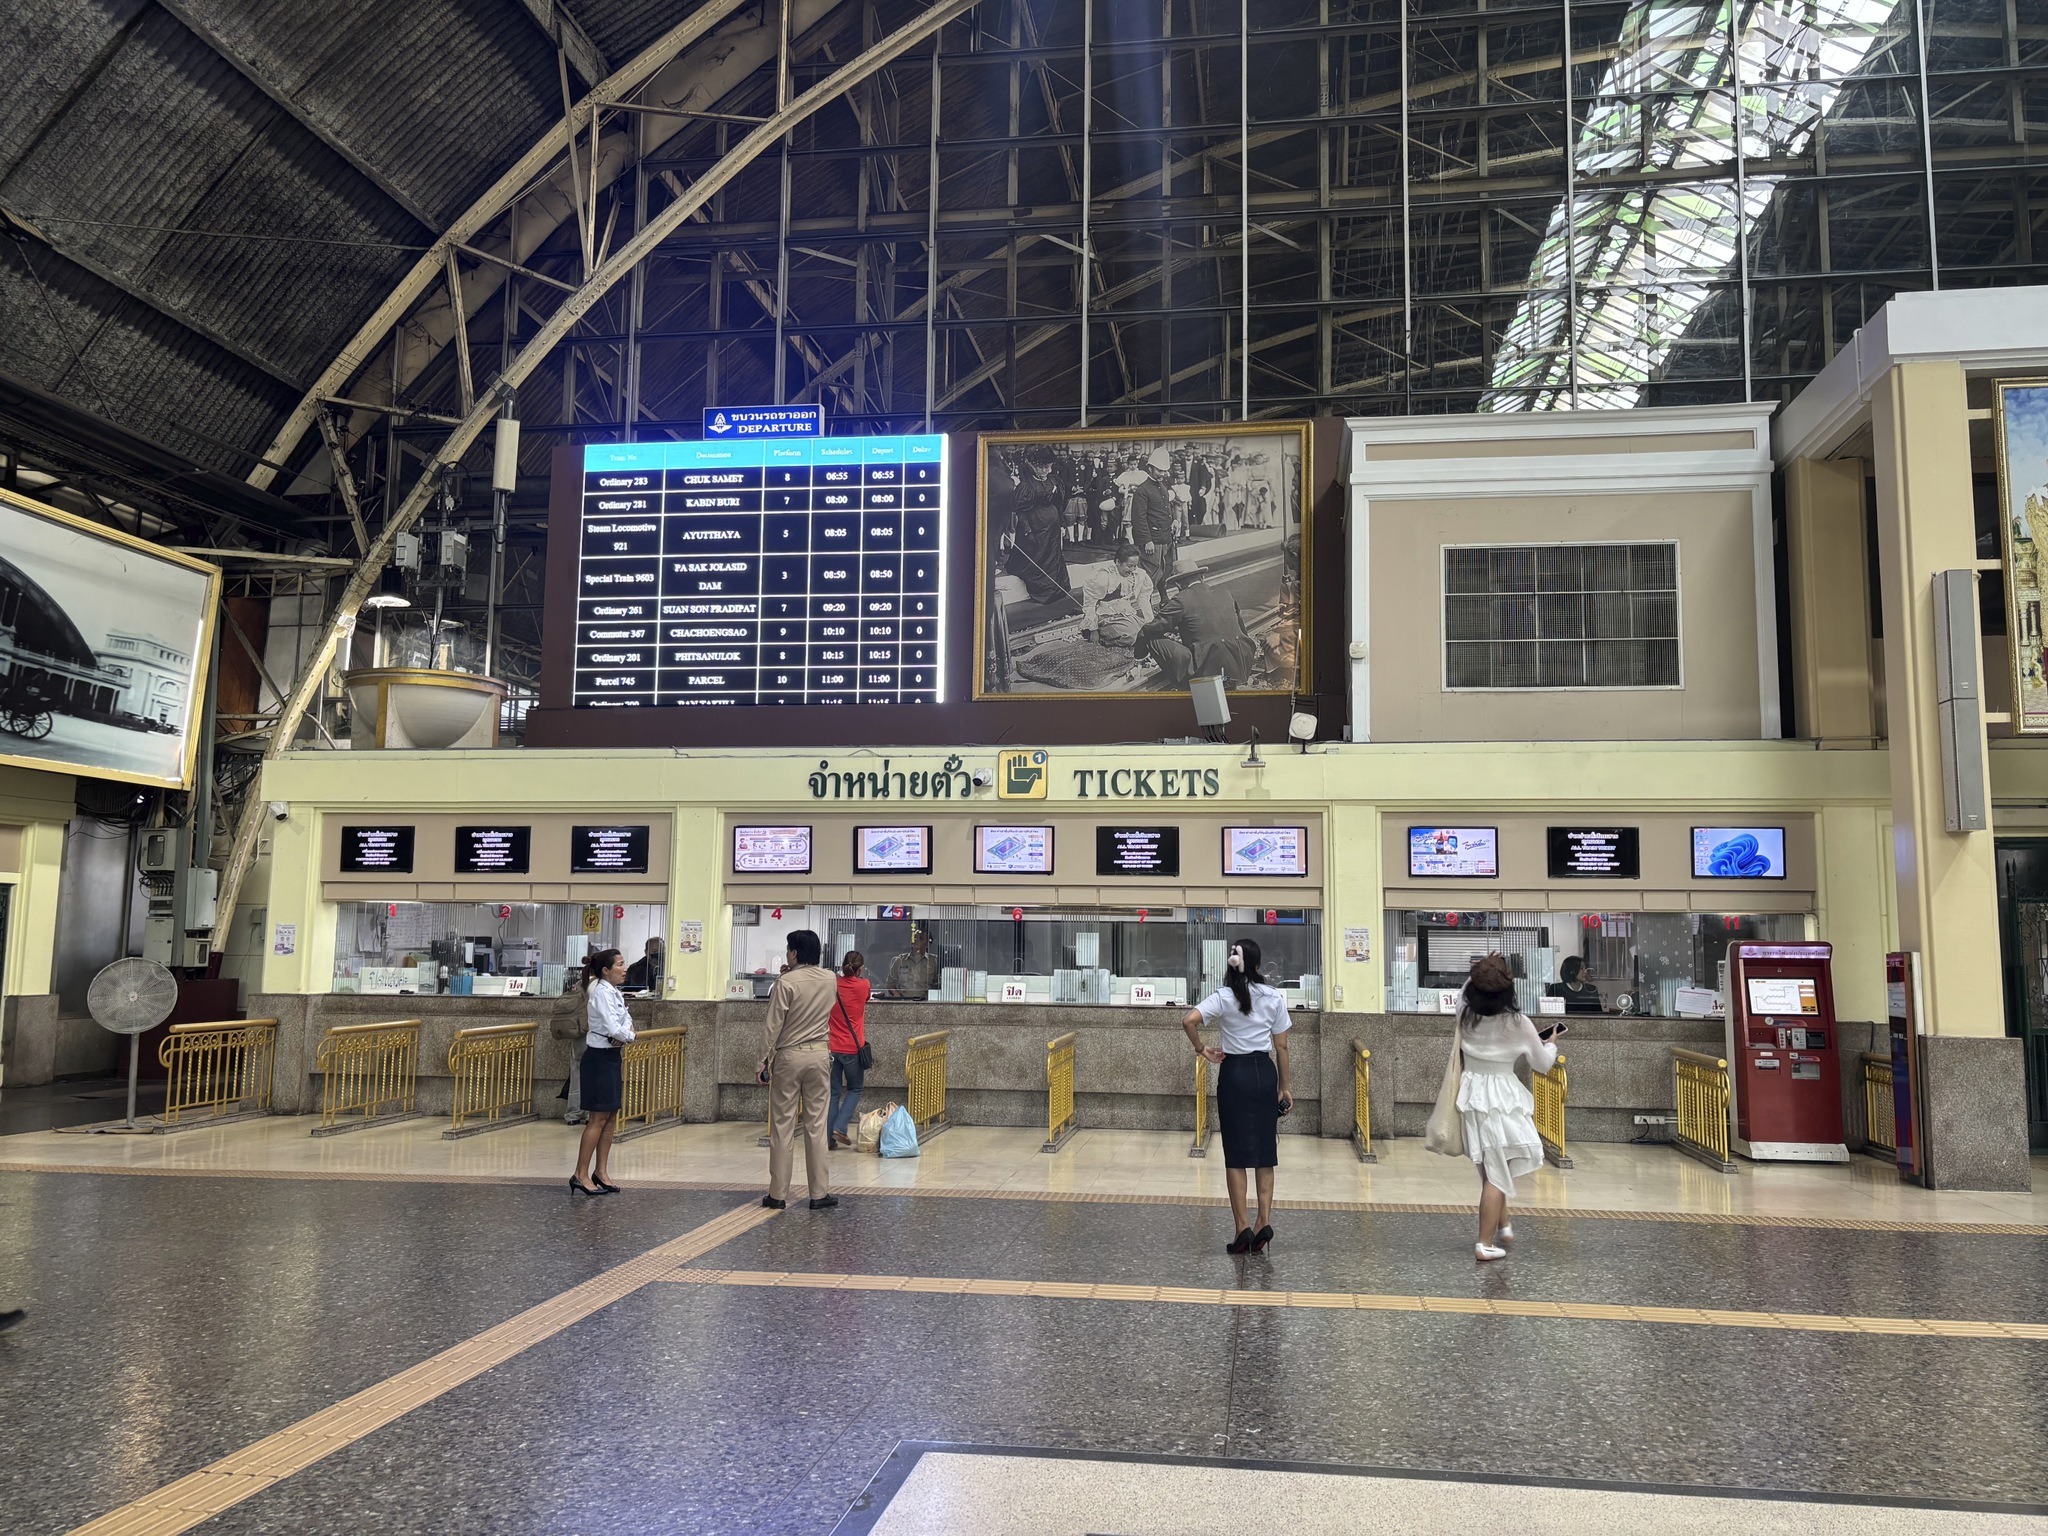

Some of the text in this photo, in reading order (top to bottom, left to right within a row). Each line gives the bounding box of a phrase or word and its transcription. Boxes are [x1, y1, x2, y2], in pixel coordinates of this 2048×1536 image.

[731, 411, 817, 422] ขบวนรถขาออก
[738, 423, 812, 434] DEPARTURE
[773, 449, 802, 457] Platform
[784, 473, 791, 481] 8
[826, 472, 849, 480] 06:55
[872, 471, 895, 480] 06:55
[919, 470, 926, 478] 0
[599, 477, 649, 488] Ordinary 283
[683, 475, 744, 484] CHUK SAMET
[784, 496, 791, 505] 7
[825, 495, 848, 504] 08:00
[871, 494, 895, 503] 08:00
[918, 493, 926, 502] 0
[598, 501, 647, 511] Ordinary 281
[686, 498, 740, 507] KABIN BURI
[587, 523, 657, 533] Steam Locomotive
[824, 528, 847, 537] 08:05
[870, 527, 894, 536] 08:05
[918, 526, 925, 535] 0
[682, 531, 741, 540] AYUTTHAYA
[782, 529, 789, 538] 5
[613, 542, 628, 551] 921
[674, 562, 748, 572] PA SAK JOLASID
[781, 571, 788, 580] 3
[823, 570, 847, 579] 08:50
[869, 569, 893, 578] 08:50
[917, 569, 924, 578] 0
[585, 573, 655, 585] Special Train 9603
[698, 582, 722, 590] DAM
[662, 604, 757, 614] SUAN SON PRADIPAT
[781, 604, 787, 612] 7
[822, 603, 846, 612] 09:20
[869, 602, 892, 611] 09:20
[916, 601, 923, 610] 0
[593, 606, 643, 617] Ordinary 261
[630, 629, 646, 638] 367
[669, 628, 748, 638] CHACHOENGSAO
[780, 627, 786, 636] 9
[822, 627, 845, 636] 10:10
[869, 626, 892, 635] 10:10
[916, 626, 923, 634] 0
[674, 652, 741, 661] PHITSANULOK
[779, 651, 786, 660] 8
[822, 650, 845, 659] 10:15
[868, 650, 891, 659] 10:15
[915, 649, 923, 658] 0
[591, 653, 641, 664] Ordinary 201
[595, 677, 636, 686] Parcel 745
[688, 676, 726, 685] PARCEL
[777, 675, 788, 684] 10
[821, 675, 844, 683] 11:00
[868, 674, 891, 683] 11:00
[915, 673, 922, 682] 0
[808, 754, 972, 800] จำหน่ายตั๋ว
[1073, 769, 1221, 798] TICKETS
[388, 903, 397, 918] 1
[500, 905, 511, 919] 2
[613, 906, 625, 920] 3
[771, 907, 782, 920] 4
[1012, 907, 1023, 922] 6
[1136, 909, 1149, 924] 7
[1266, 909, 1278, 925] 8
[1446, 912, 1459, 927] 9
[1581, 914, 1602, 929] 10
[1722, 915, 1740, 930] 11
[509, 979, 524, 989] ปิด
[1006, 985, 1022, 996] ปิด
[1134, 987, 1151, 998] ปิด
